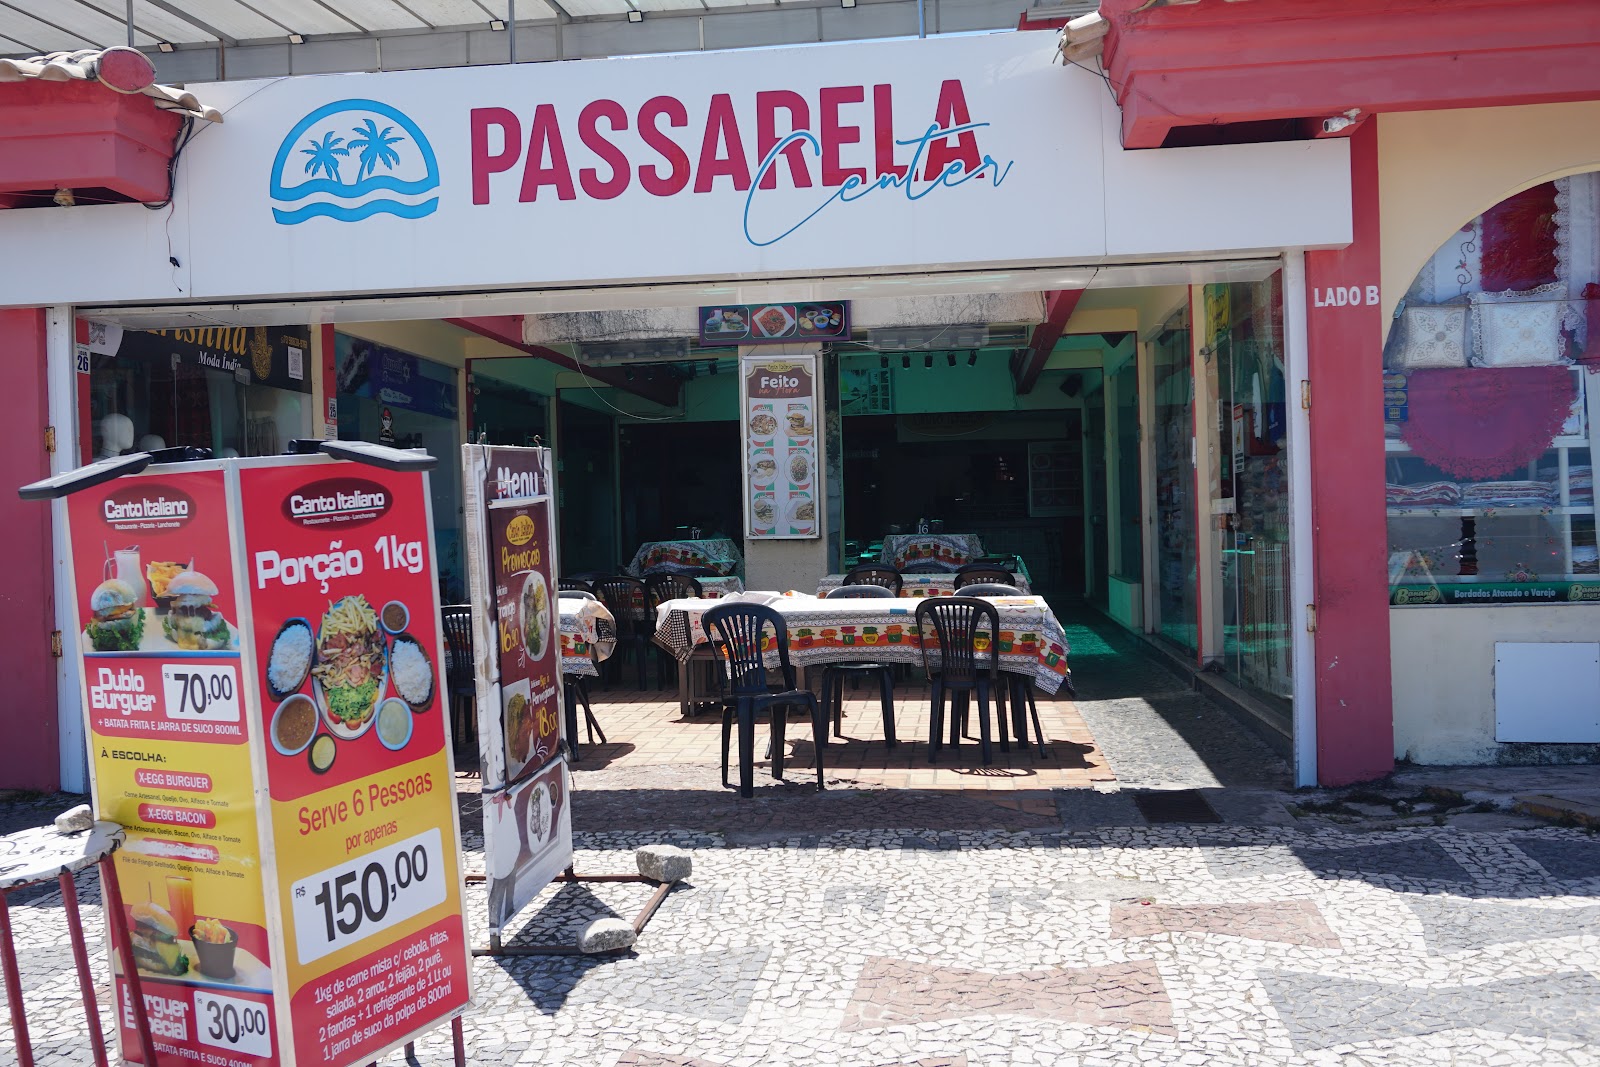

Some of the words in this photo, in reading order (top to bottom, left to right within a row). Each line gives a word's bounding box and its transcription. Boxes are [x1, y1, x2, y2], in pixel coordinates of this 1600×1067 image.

[470, 79, 985, 206] PASSARELA
[743, 122, 1014, 247] Center
[1314, 286, 1361, 307] LADO
[1366, 285, 1380, 306] B
[77, 355, 89, 372] 26
[198, 351, 221, 368] Moda
[760, 374, 799, 389] Feito
[497, 466, 539, 498] Menu
[104, 499, 143, 519] Canto
[143, 497, 188, 516] Italiano
[290, 495, 336, 515] Canto
[337, 490, 385, 510] Italiano
[691, 529, 701, 540] 17
[917, 524, 929, 534] 16
[255, 540, 363, 594] Porção
[374, 534, 424, 574] 1kg
[501, 541, 541, 573] Promoção
[1454, 589, 1491, 598] Bordados
[1492, 588, 1523, 598] Atacado
[1531, 588, 1556, 599] Varejo
[98, 667, 145, 692] Dublo
[91, 685, 157, 715] Burguer
[174, 673, 233, 714] 70,00
[105, 718, 129, 728] BATATA
[130, 719, 150, 730] FRITA
[151, 720, 156, 730] E
[157, 721, 181, 732] JARRA
[182, 722, 193, 733] DE
[193, 723, 214, 734] SUCO
[215, 725, 242, 736] 800ML
[101, 747, 109, 759] À
[112, 750, 167, 763] ESCOLHA:
[138, 772, 165, 785] X-EGG
[166, 774, 209, 789] BURGUER
[147, 808, 174, 821] X-EGG
[175, 811, 207, 825] BACON
[298, 800, 348, 836] Serve
[352, 789, 365, 817] 6
[368, 772, 433, 811] Pessoas
[345, 834, 361, 854] por
[363, 820, 398, 845] apenas
[295, 886, 306, 898] R$
[314, 844, 428, 942] 150,00
[314, 984, 332, 1004] 1kg
[334, 978, 345, 995] de
[346, 969, 369, 989] carne
[370, 958, 393, 978] mista
[393, 949, 402, 968] c/
[403, 938, 430, 961] cebola,
[429, 930, 449, 948] fritas,
[326, 995, 357, 1019] salada,
[357, 988, 364, 1003] 2
[365, 980, 387, 1000] arroz,
[388, 973, 394, 988] 2
[395, 964, 418, 985] feijão,
[418, 958, 424, 972] 2
[425, 949, 443, 973] purê,
[319, 1026, 326, 1043] 2
[327, 1014, 357, 1039] farofas
[358, 1010, 364, 1020] +
[365, 1004, 372, 1019] 1
[373, 984, 415, 1015] refrigerante
[416, 977, 426, 992] de
[427, 973, 434, 987] 1
[434, 969, 441, 983] Lt
[442, 965, 452, 979] ou
[206, 1000, 266, 1044] 30,00
[323, 1045, 330, 1061] 1
[331, 1037, 351, 1060] jarra
[352, 1031, 363, 1046] de
[364, 1020, 383, 1039] suco
[383, 1013, 394, 1029] da
[396, 1001, 416, 1026] polpa
[417, 996, 427, 1010] de
[427, 980, 452, 1005] 800ml
[179, 1047, 200, 1060] FRITA
[200, 1052, 206, 1061] E
[206, 1054, 228, 1067] SUCO
